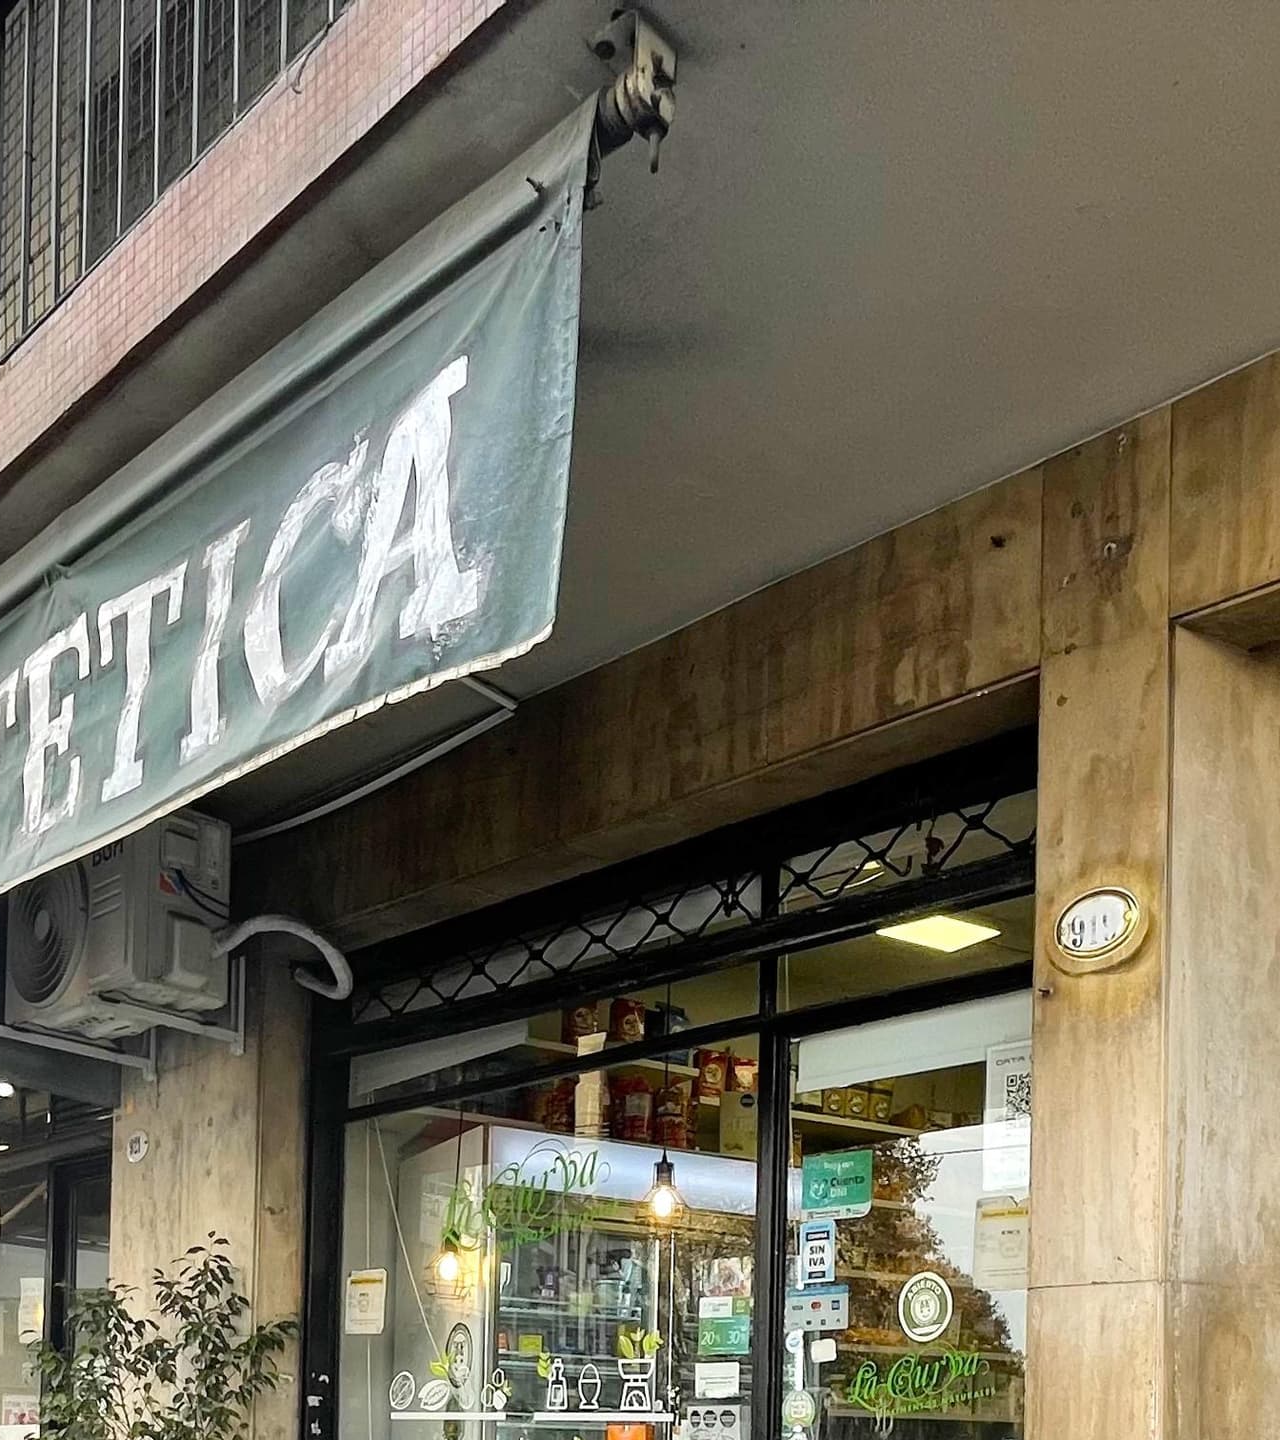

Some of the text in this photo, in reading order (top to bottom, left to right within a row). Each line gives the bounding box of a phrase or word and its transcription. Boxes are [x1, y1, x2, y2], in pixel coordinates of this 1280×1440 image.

[830, 1174, 866, 1188] Cuenta
[809, 1244, 826, 1256] SIN
[808, 1256, 826, 1268] IVA
[906, 1279, 942, 1301] ABIERTO
[847, 1341, 990, 1411] La Curva
